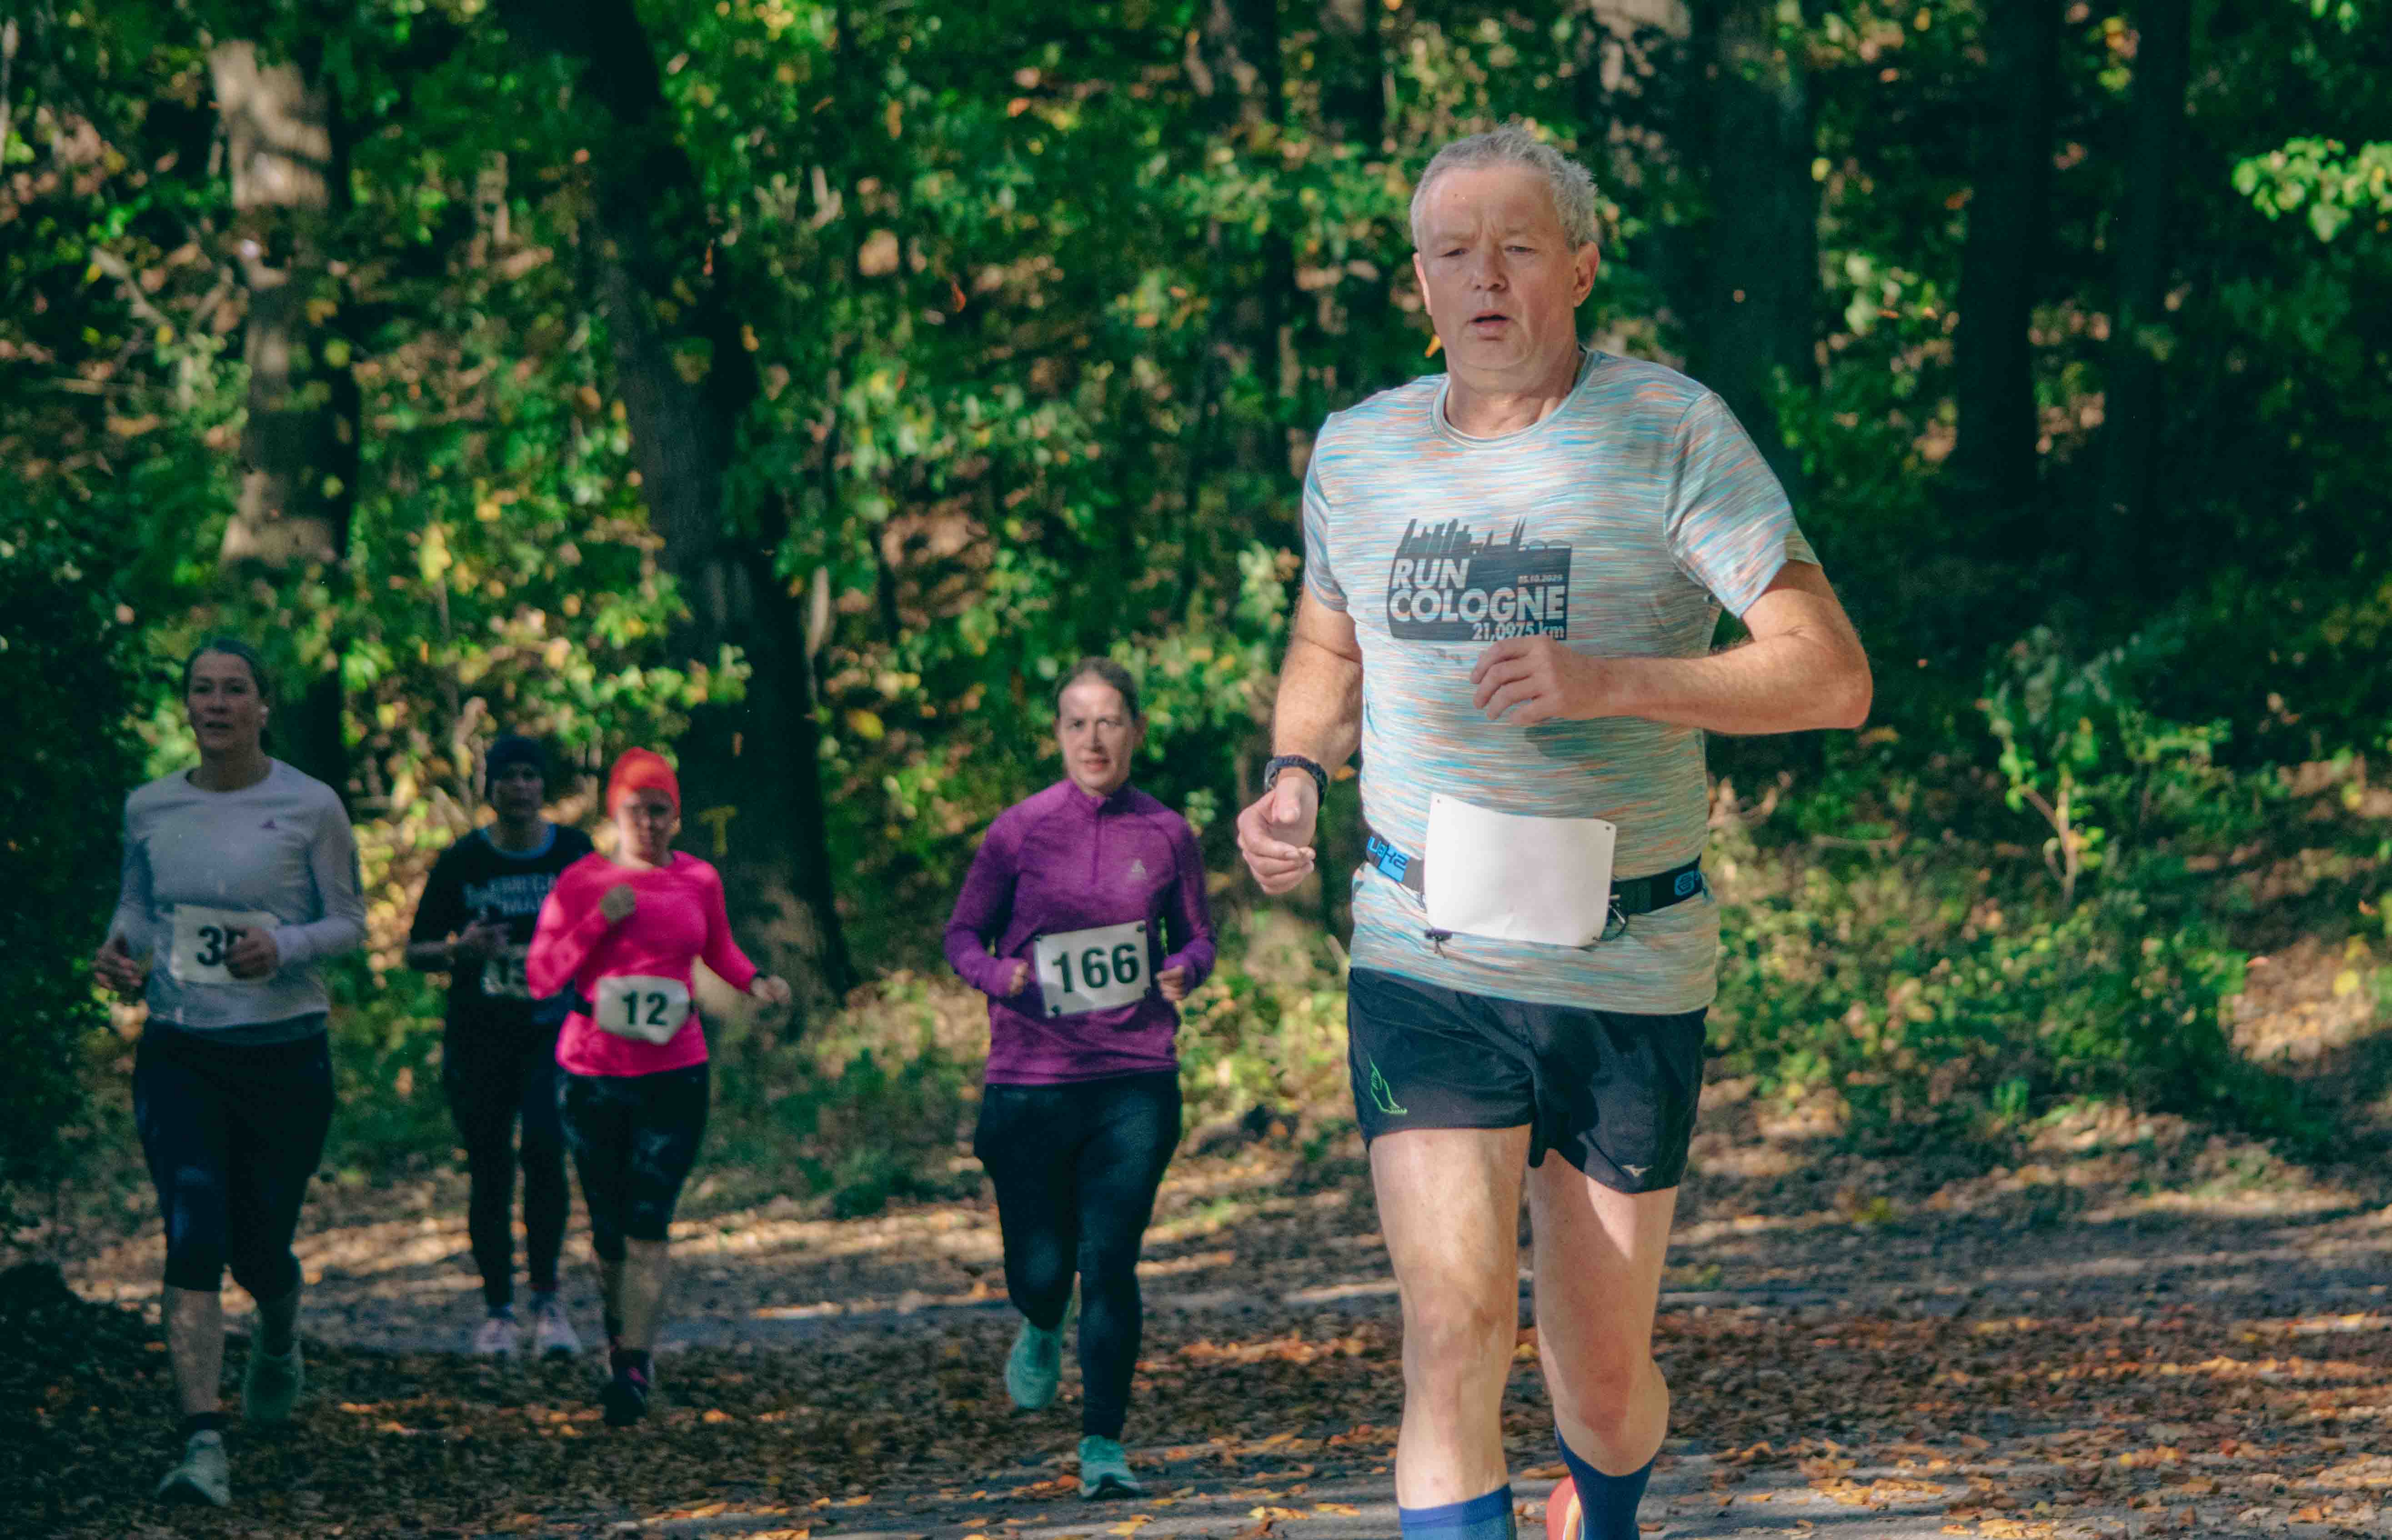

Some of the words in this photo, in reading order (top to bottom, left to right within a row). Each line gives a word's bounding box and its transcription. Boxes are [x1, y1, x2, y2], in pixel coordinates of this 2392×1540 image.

[1391, 558, 1470, 590] RUN
[1390, 585, 1565, 622] COLOGNE
[1472, 621, 1534, 641] 21,0975
[1539, 620, 1565, 639] km
[1053, 942, 1139, 993] 166
[622, 990, 669, 1026] 12
